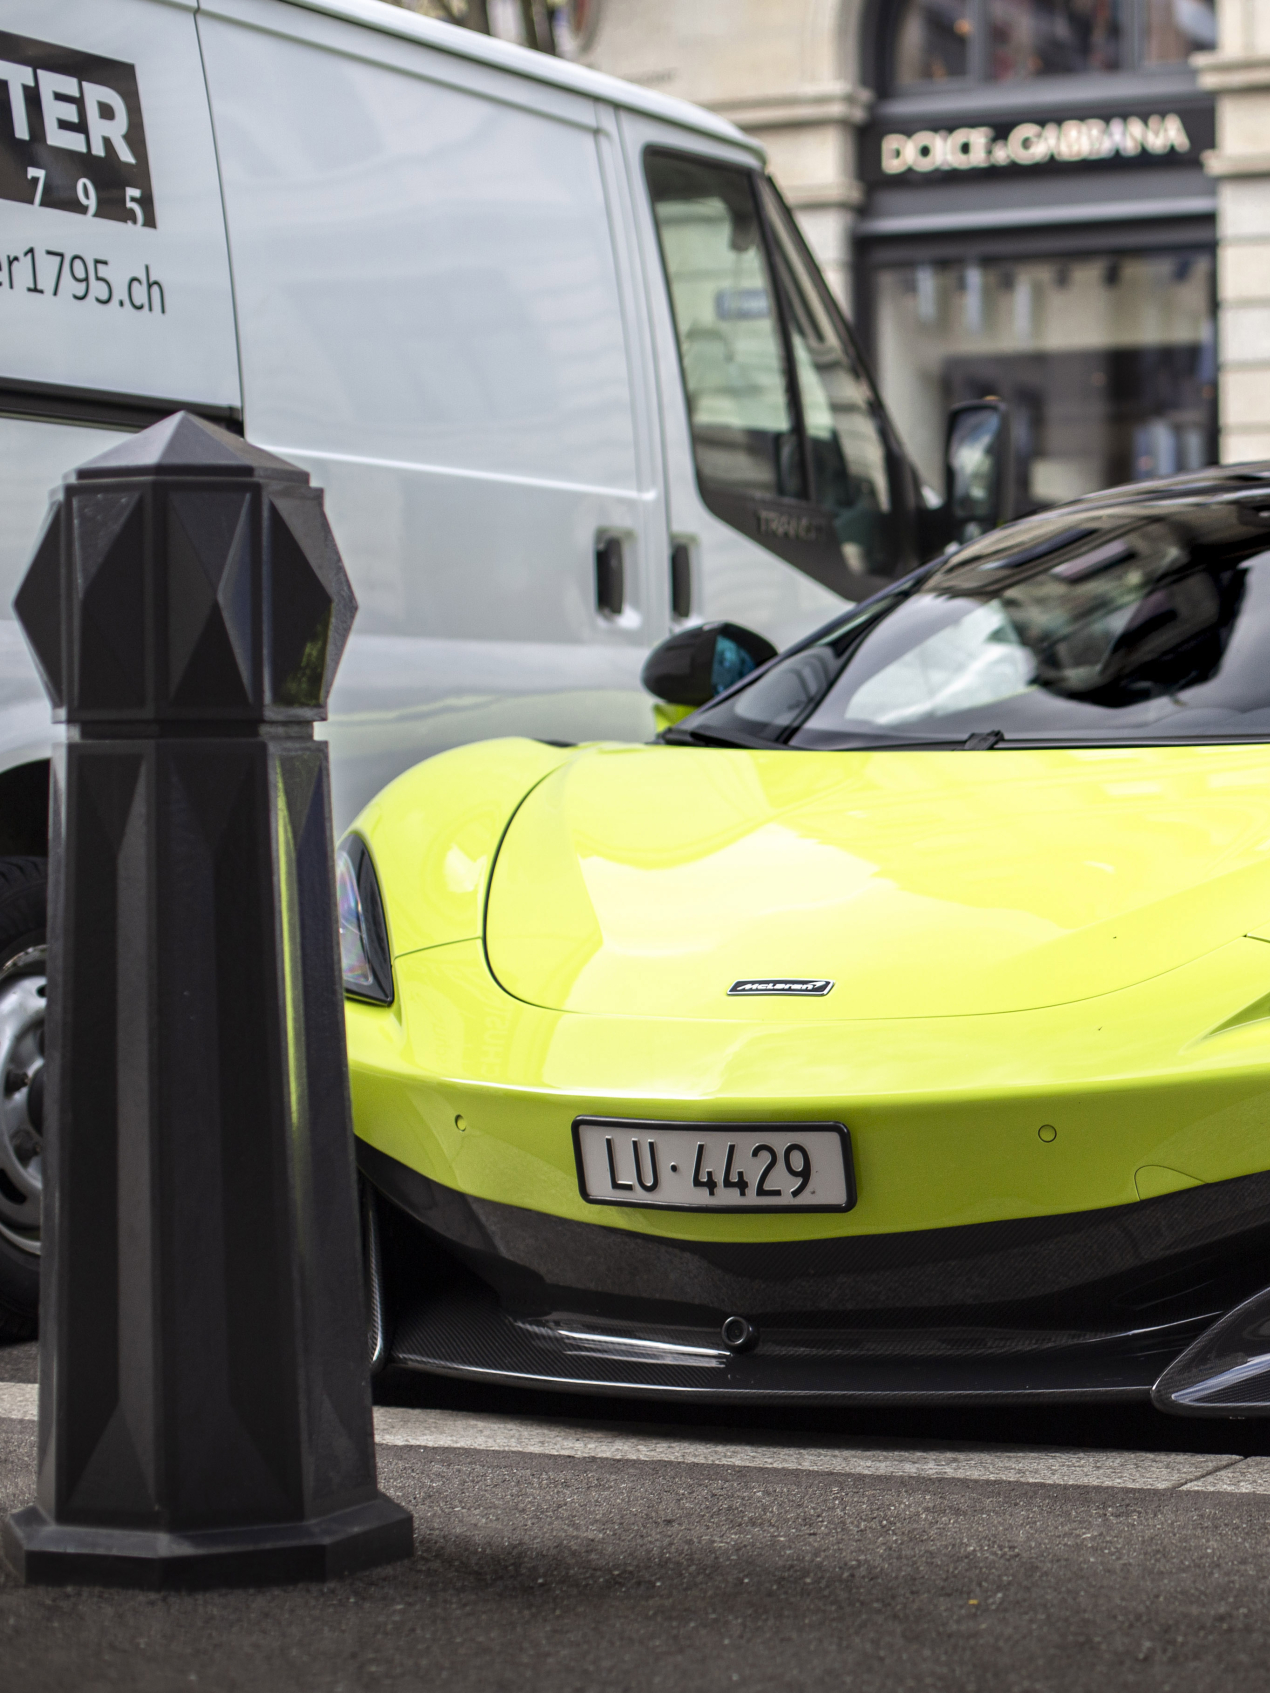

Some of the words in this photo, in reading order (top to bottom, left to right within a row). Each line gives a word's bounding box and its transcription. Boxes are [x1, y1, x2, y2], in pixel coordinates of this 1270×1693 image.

[0, 60, 137, 165] TER
[0, 246, 166, 314] r1795.ch
[736, 982, 815, 990] McLaren
